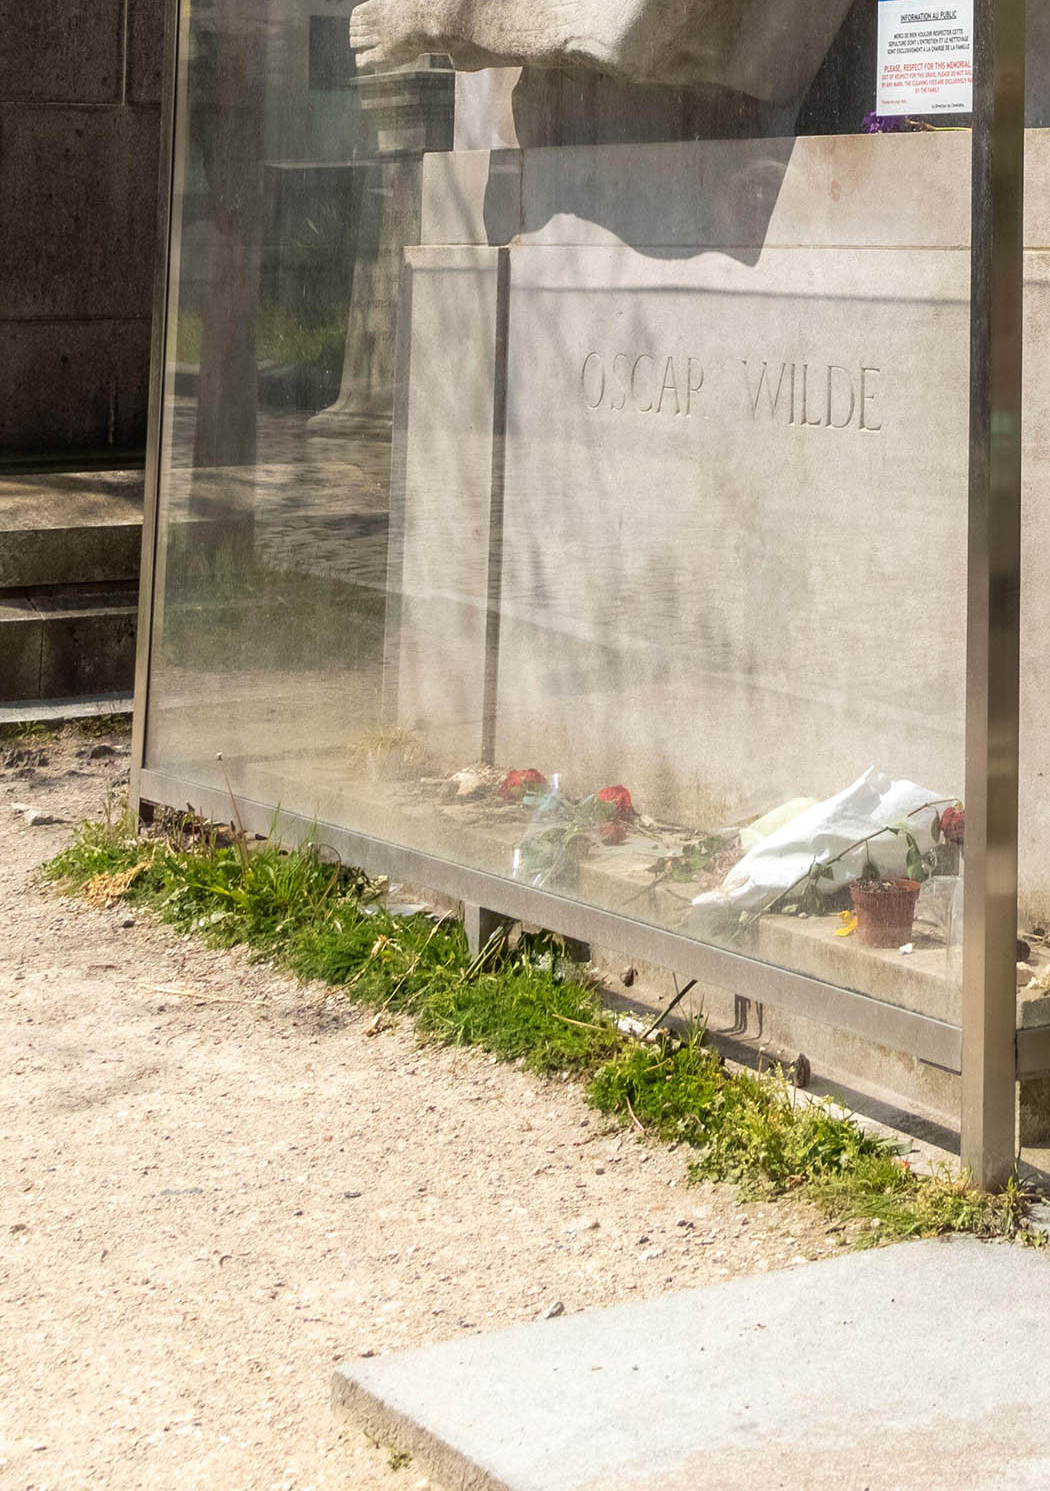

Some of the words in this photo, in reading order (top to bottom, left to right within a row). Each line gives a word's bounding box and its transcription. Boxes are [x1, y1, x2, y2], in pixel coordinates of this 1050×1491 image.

[900, 12, 932, 22] INFORMATION
[932, 12, 940, 20] AU
[940, 10, 957, 19] PUBLIC
[903, 63, 923, 71] RESPECT
[924, 62, 934, 70] FOR
[935, 61, 946, 70] THIS
[741, 360, 882, 432] WILDE
